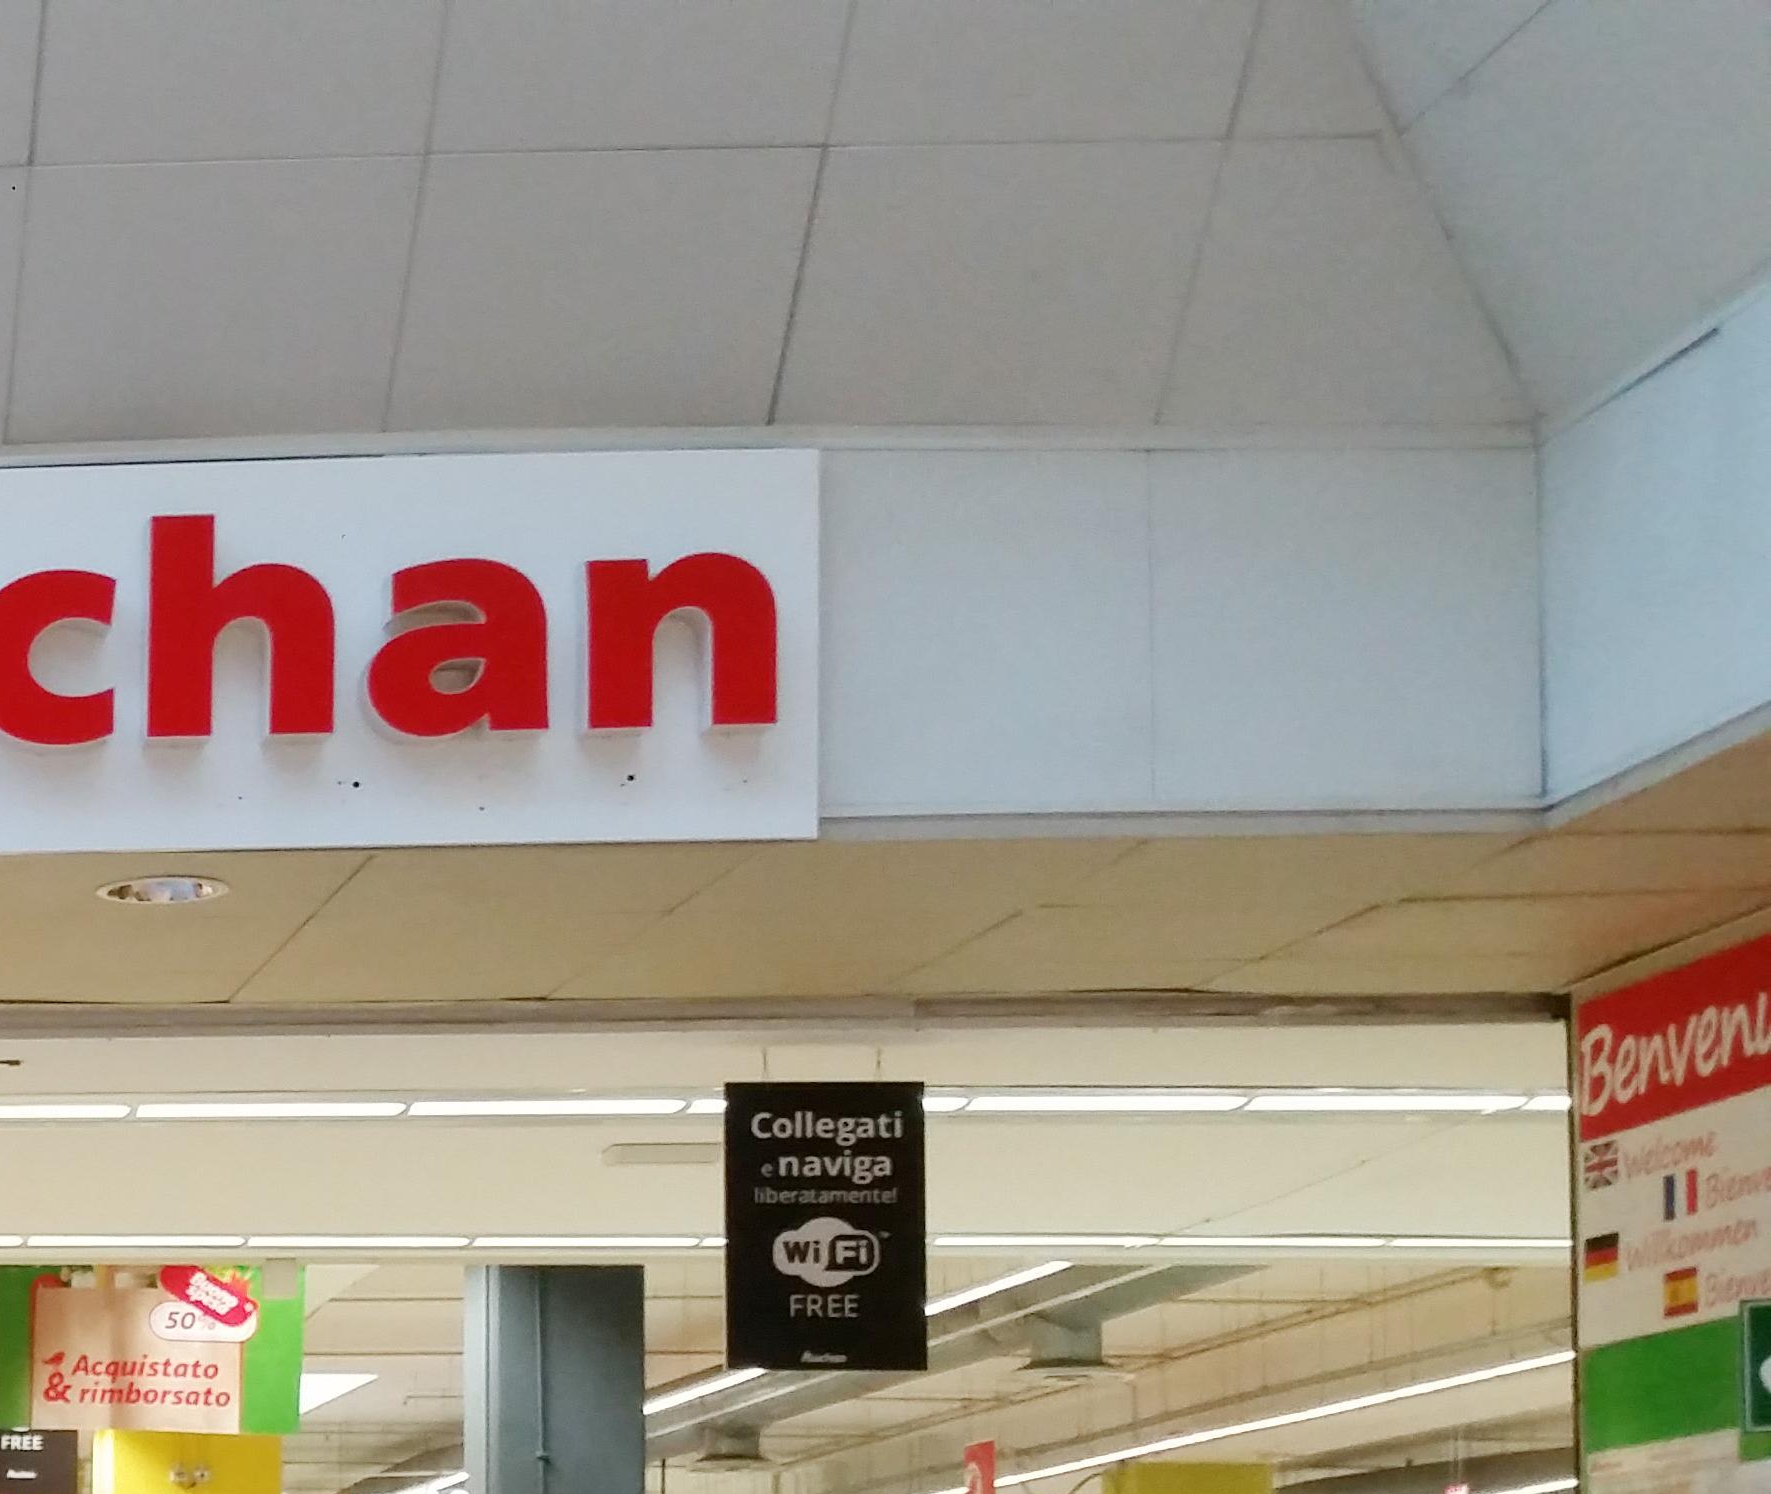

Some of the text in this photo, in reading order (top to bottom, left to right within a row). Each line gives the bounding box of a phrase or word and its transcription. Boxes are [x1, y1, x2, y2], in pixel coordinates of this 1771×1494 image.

[750, 1110, 903, 1146] Collegati
[761, 1150, 893, 1185] e naviga
[790, 1293, 860, 1318] FREE
[71, 1355, 219, 1384] Acquistato
[79, 1382, 231, 1407] rimborsato
[1, 1434, 44, 1451] FREE
